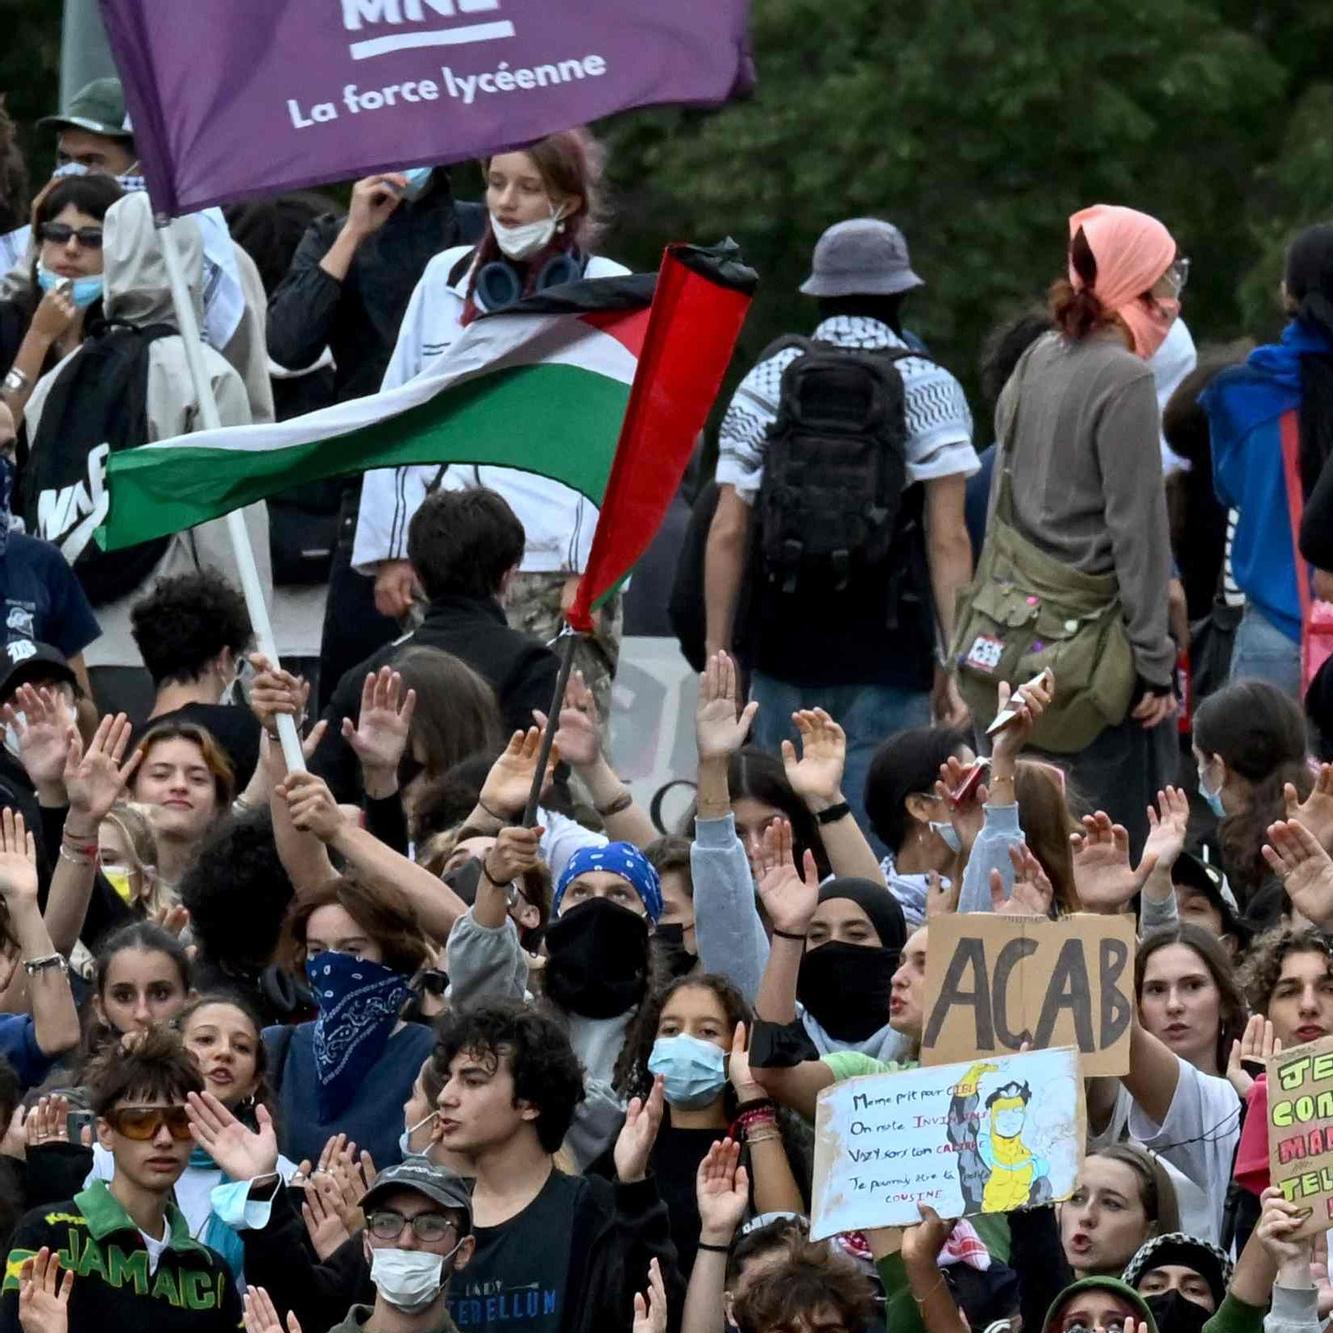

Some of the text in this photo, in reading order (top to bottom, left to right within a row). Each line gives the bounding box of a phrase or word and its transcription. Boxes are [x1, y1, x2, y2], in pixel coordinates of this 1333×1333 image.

[287, 54, 607, 129] La force lycéenne
[923, 937, 1130, 1053] ACAB
